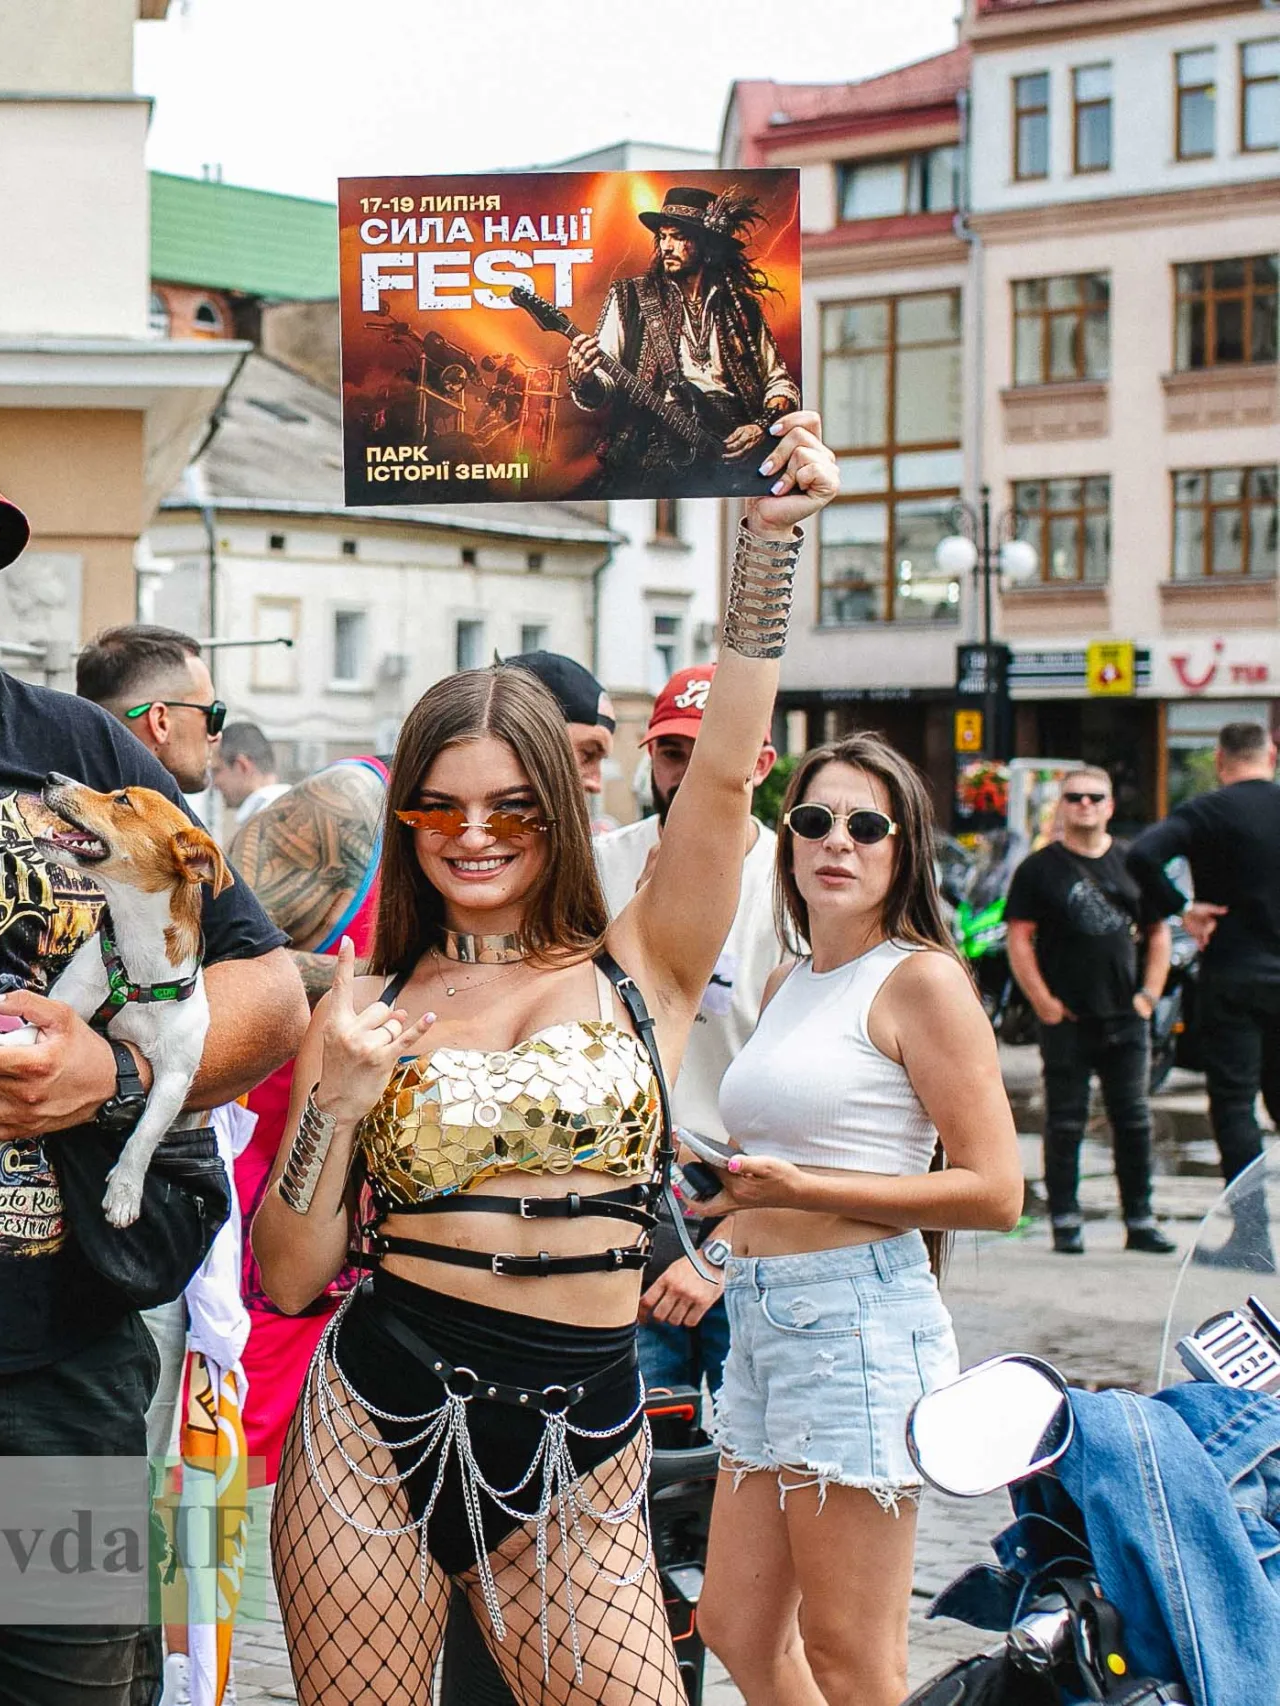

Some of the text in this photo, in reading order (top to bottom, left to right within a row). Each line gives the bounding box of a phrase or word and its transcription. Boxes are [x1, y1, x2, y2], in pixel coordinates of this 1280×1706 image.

[360, 195, 501, 213] 17-19 ЛИПНЯ
[360, 207, 592, 246] СИЛА НАЦІЇ
[360, 248, 594, 312] FEST
[366, 446, 429, 463] ПАРК
[367, 462, 529, 483] ІСТОРІЇ ЗЕМЛІ
[32, 1191, 61, 1214] Roc
